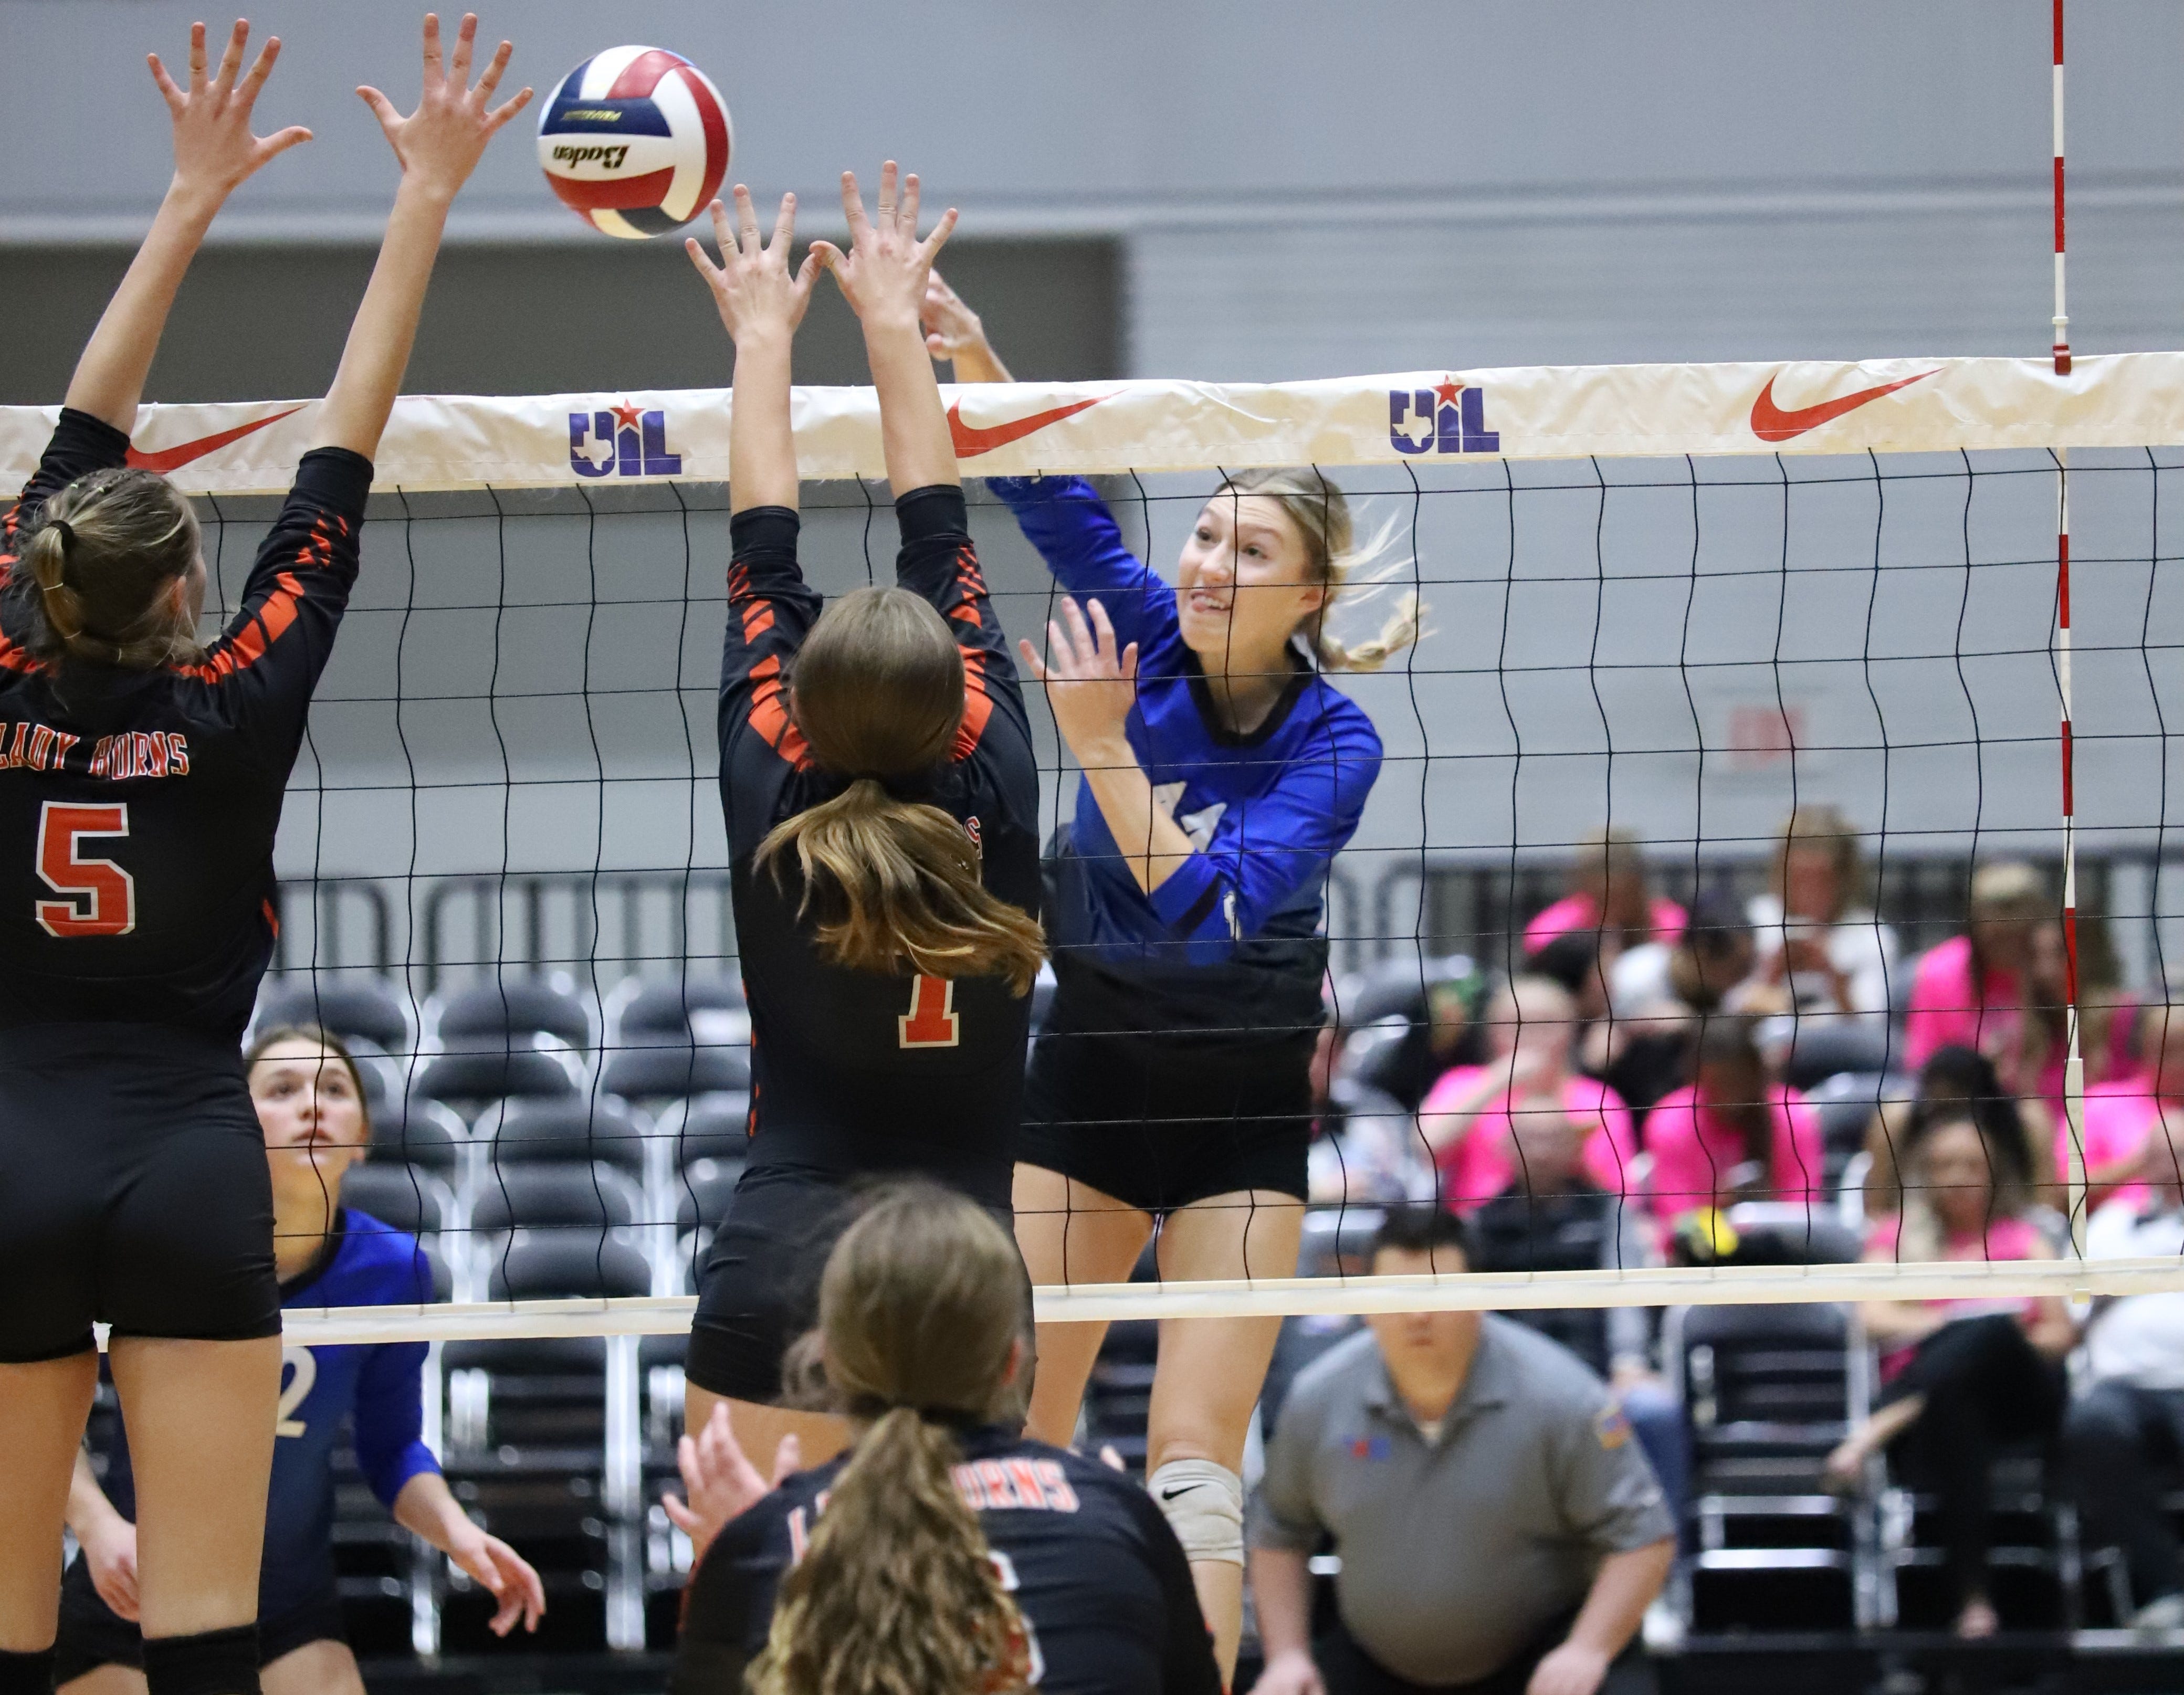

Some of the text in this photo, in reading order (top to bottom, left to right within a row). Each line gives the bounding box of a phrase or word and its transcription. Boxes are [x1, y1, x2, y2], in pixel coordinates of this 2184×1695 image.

[554, 145, 629, 168] Baden
[569, 399, 681, 477] UIL
[1390, 375, 1499, 454] UIL
[88, 731, 189, 780] HORNS
[36, 801, 135, 937] 5
[949, 1457, 1079, 1512] ORNS
